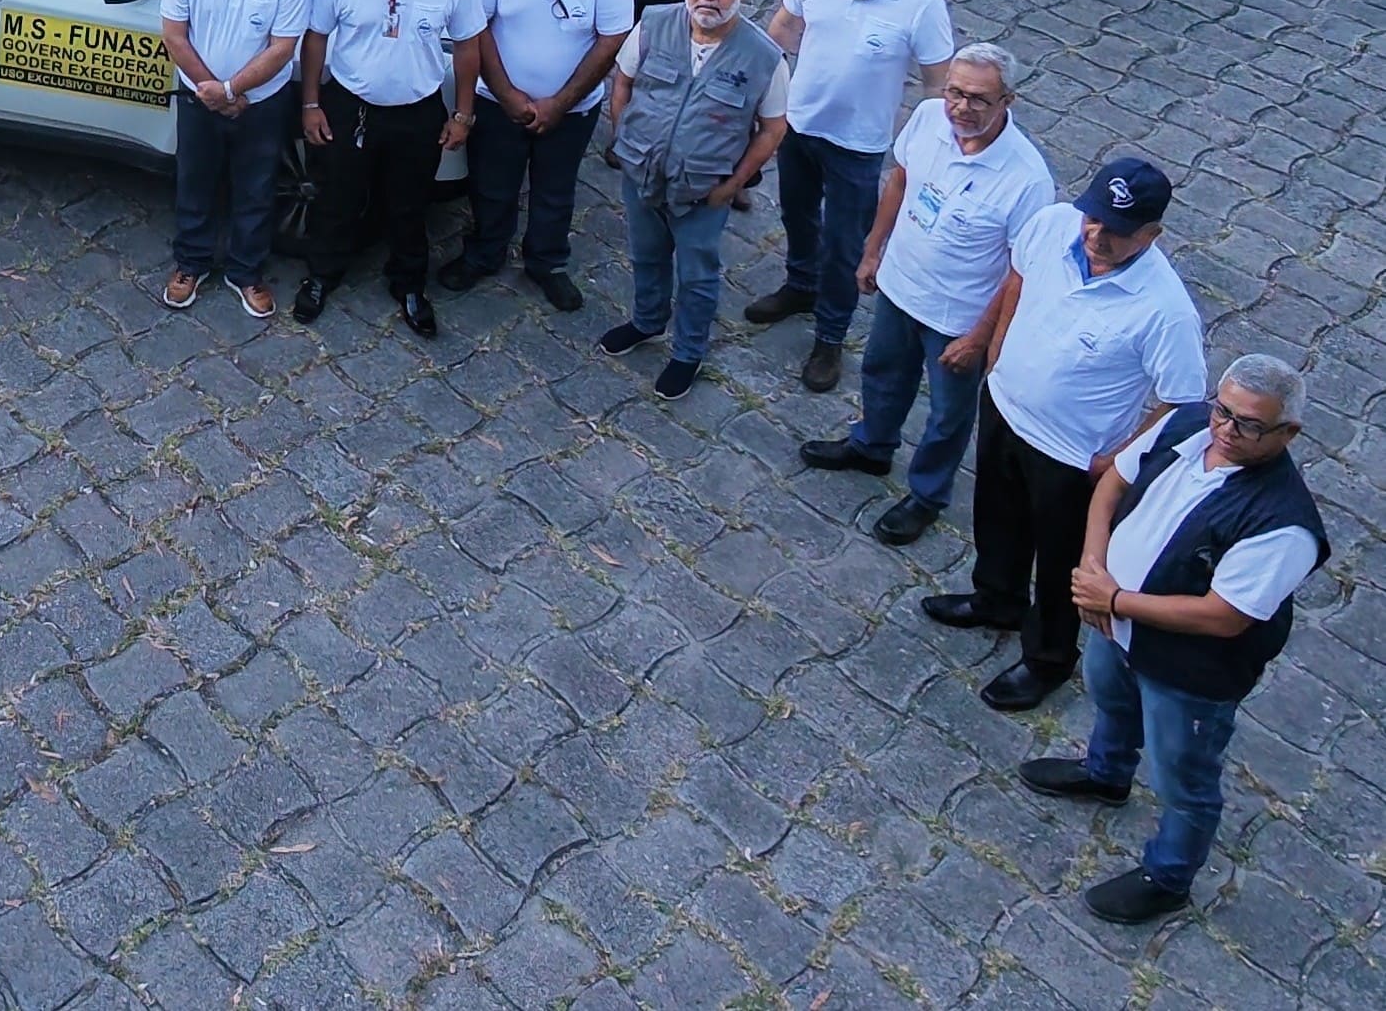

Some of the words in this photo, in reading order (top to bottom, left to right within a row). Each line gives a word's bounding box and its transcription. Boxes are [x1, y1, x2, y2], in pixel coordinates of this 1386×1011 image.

[2, 37, 87, 63] GOVERNO
[91, 52, 170, 77] FEDERAL
[69, 25, 171, 62] FUNASA
[0, 67, 25, 80] USO
[27, 73, 93, 92] EXCLUSIVO
[95, 84, 113, 95] EM
[5, 52, 63, 74] PODER
[68, 64, 165, 90] EXECUTIVO
